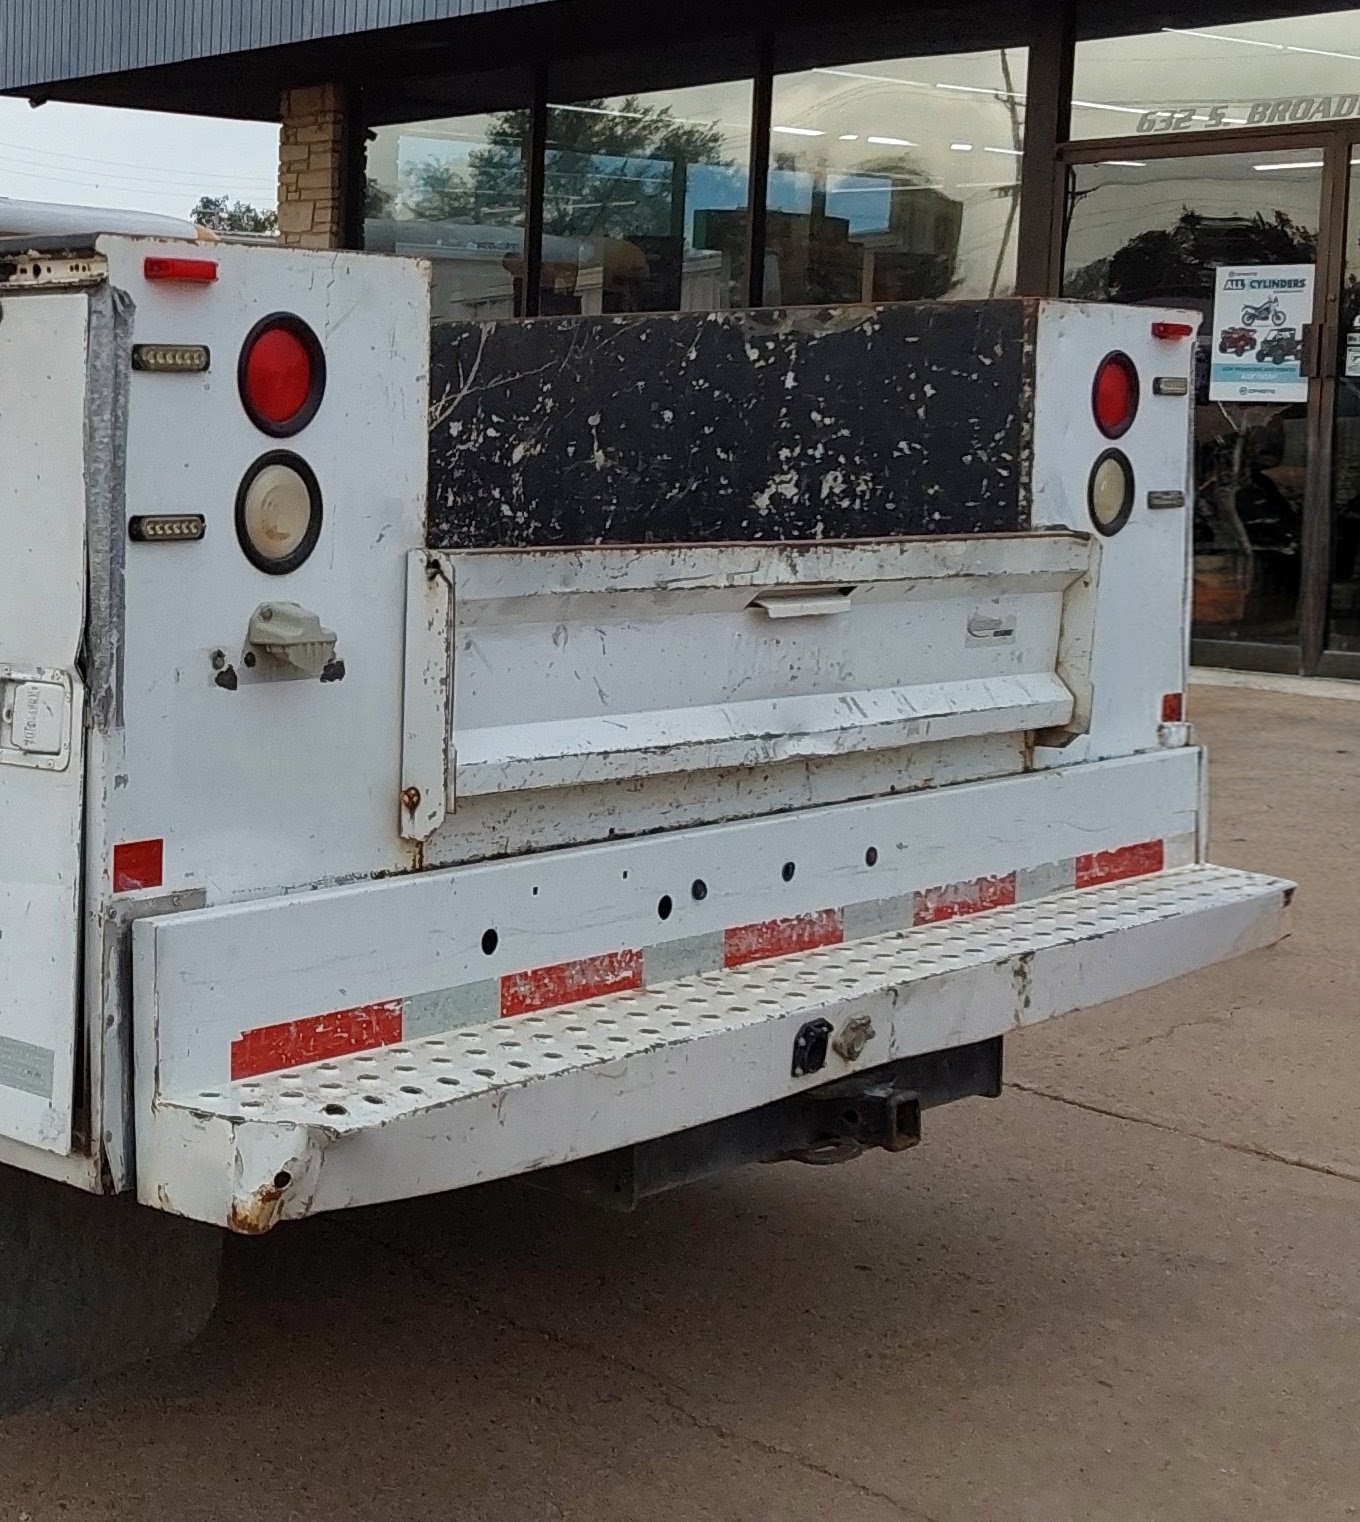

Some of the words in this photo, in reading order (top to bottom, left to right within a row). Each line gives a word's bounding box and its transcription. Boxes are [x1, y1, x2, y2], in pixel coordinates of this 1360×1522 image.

[1136, 108, 1196, 132] 632
[1247, 94, 1360, 124] BROAD
[1223, 279, 1246, 290] ALL
[1249, 279, 1306, 289] CYLINDERS
